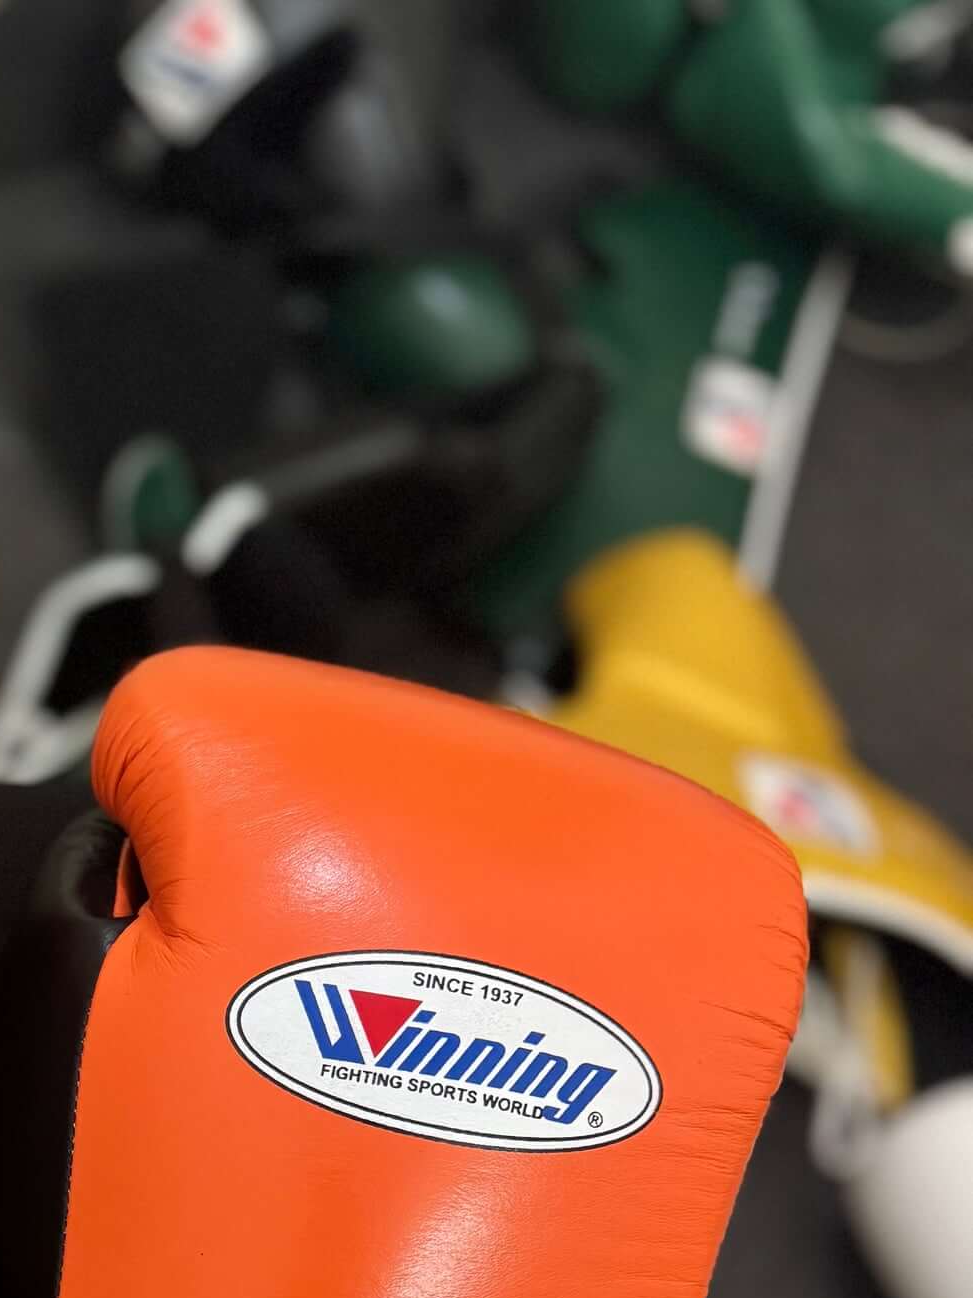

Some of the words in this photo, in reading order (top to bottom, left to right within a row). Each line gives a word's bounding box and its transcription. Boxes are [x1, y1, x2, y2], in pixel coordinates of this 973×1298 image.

[413, 971, 473, 997] SINCE
[480, 985, 524, 1008] 1937
[294, 979, 617, 1125] Winning
[320, 1064, 403, 1091] FIGHTING
[407, 1078, 477, 1105] SPORTS
[482, 1093, 544, 1121] WORLD
